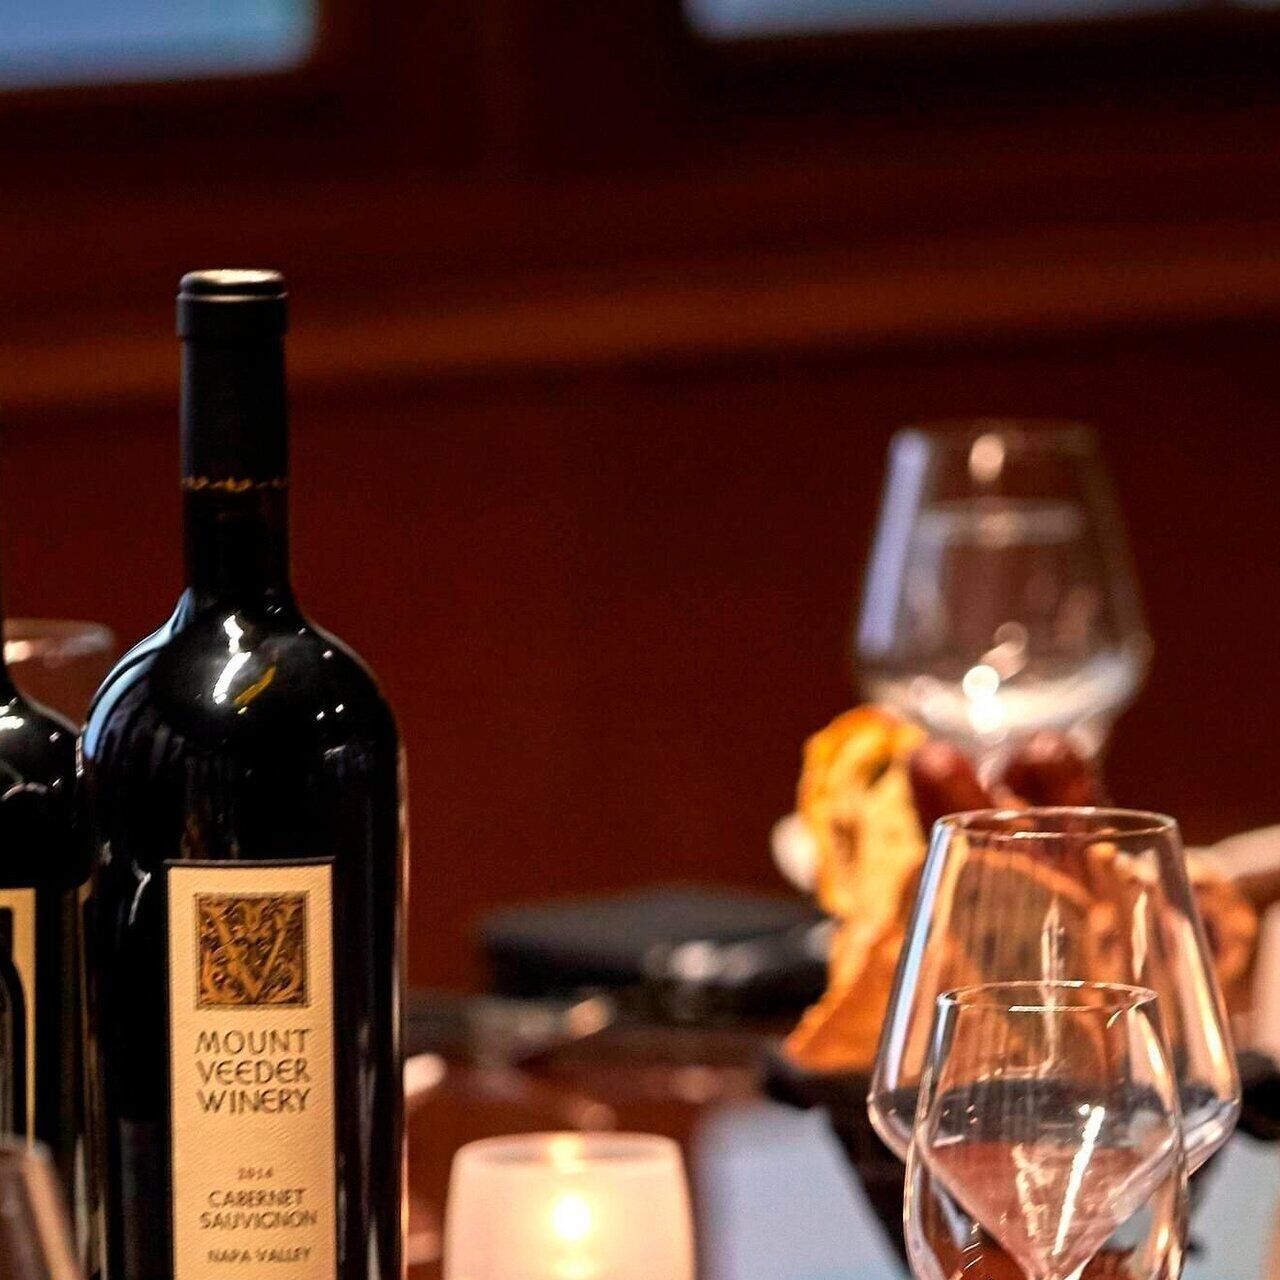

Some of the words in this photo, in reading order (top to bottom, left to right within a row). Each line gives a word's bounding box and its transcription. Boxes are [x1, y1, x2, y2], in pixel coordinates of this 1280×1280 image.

[194, 1028, 311, 1055] MOUNT
[194, 1057, 312, 1086] VEEDER
[195, 1087, 311, 1115] WINERY
[207, 1187, 306, 1208] CABERNET
[199, 1208, 318, 1230] SAUVIGNON
[206, 1248, 252, 1263] NAPA
[255, 1245, 312, 1263] VALLEY
